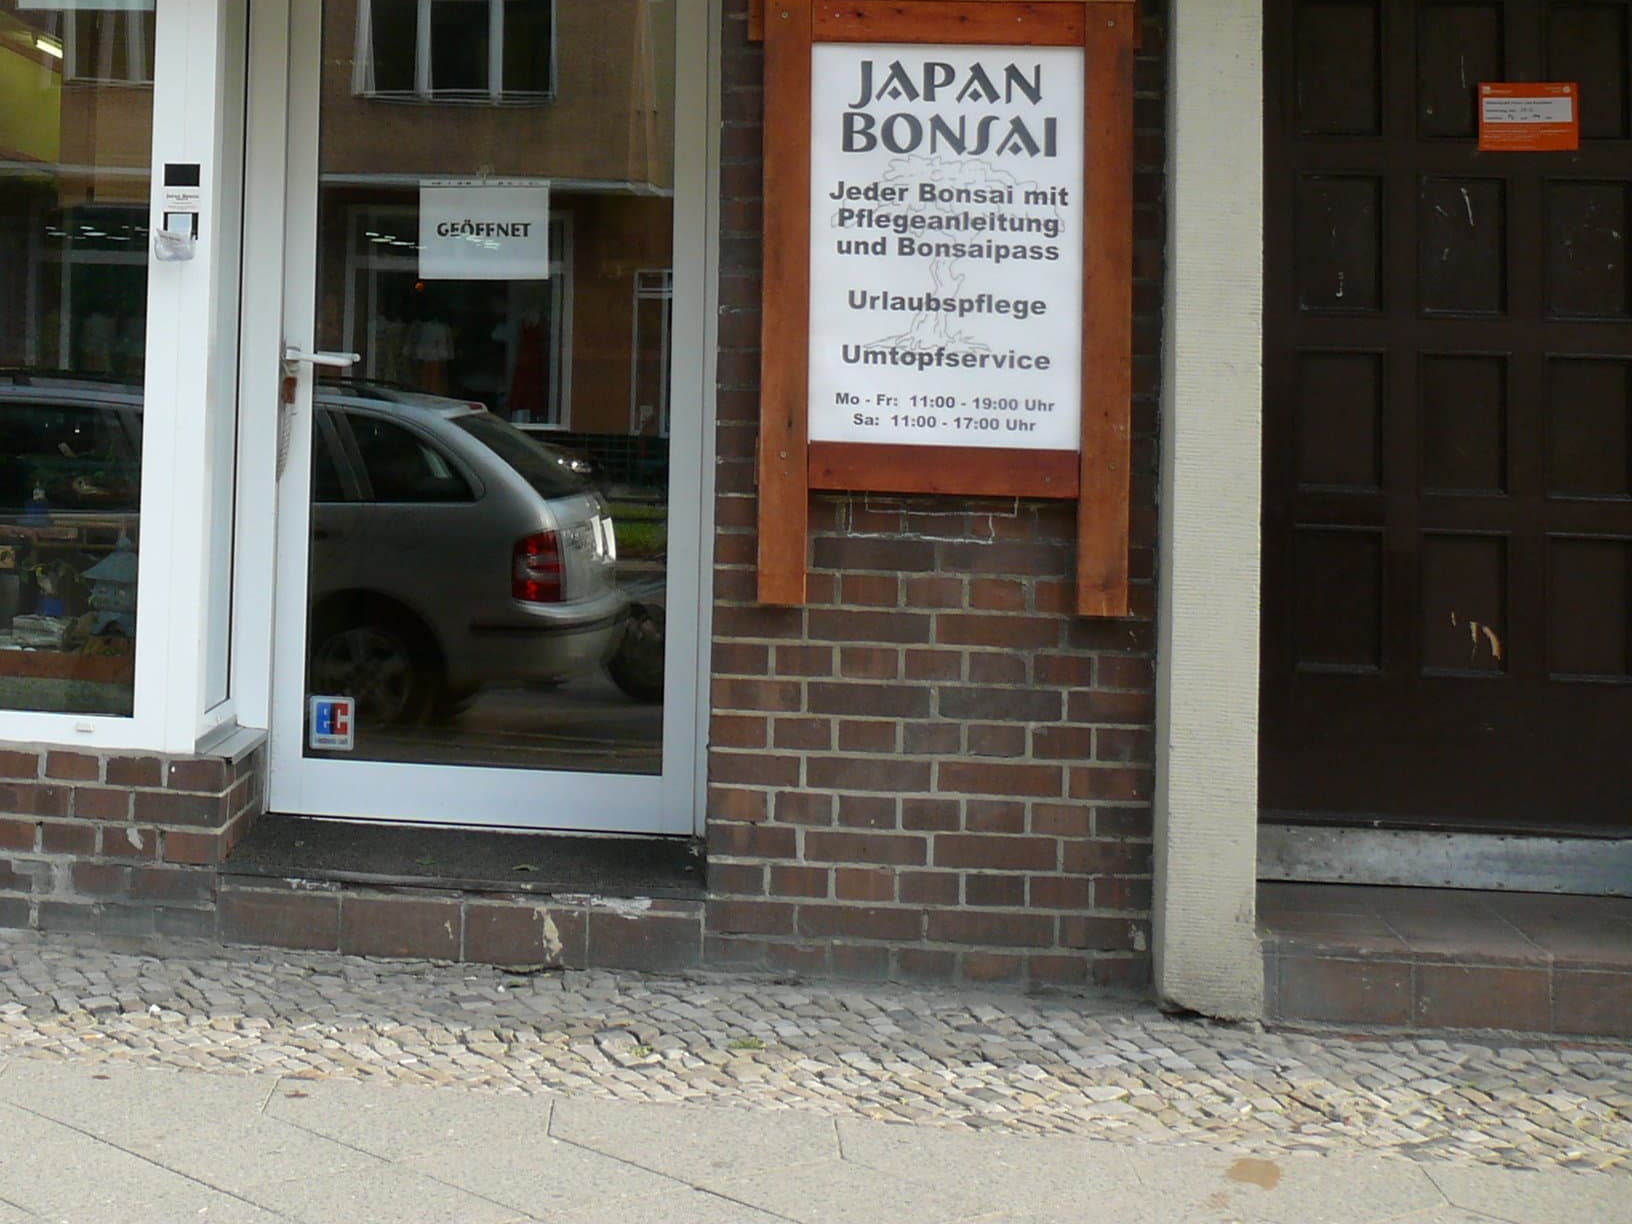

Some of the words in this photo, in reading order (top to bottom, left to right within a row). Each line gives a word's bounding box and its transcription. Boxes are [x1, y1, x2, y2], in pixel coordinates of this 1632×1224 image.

[848, 60, 1043, 110] JAPAN
[842, 112, 1057, 158] BONSAI
[829, 181, 909, 202] Jeder
[919, 183, 1014, 205] Bonsai
[1023, 186, 1069, 206] mit
[436, 219, 532, 238] GEÖFFNET
[838, 208, 1059, 238] Pflegeanleitung
[837, 237, 887, 256] und
[898, 237, 1059, 263] Bonsaipass
[848, 290, 1047, 319] Urlaubspflege
[842, 344, 1051, 371] Umtopfservice
[835, 392, 860, 406] Mo
[876, 394, 899, 407] Fr:
[909, 395, 956, 409] 11:00
[971, 397, 1019, 411] 19:00
[1024, 399, 1056, 412] Uhr
[853, 413, 880, 426] Sa:
[891, 415, 937, 428] 11:00
[953, 417, 1000, 430] 17:00
[1005, 419, 1037, 432] Uhr
